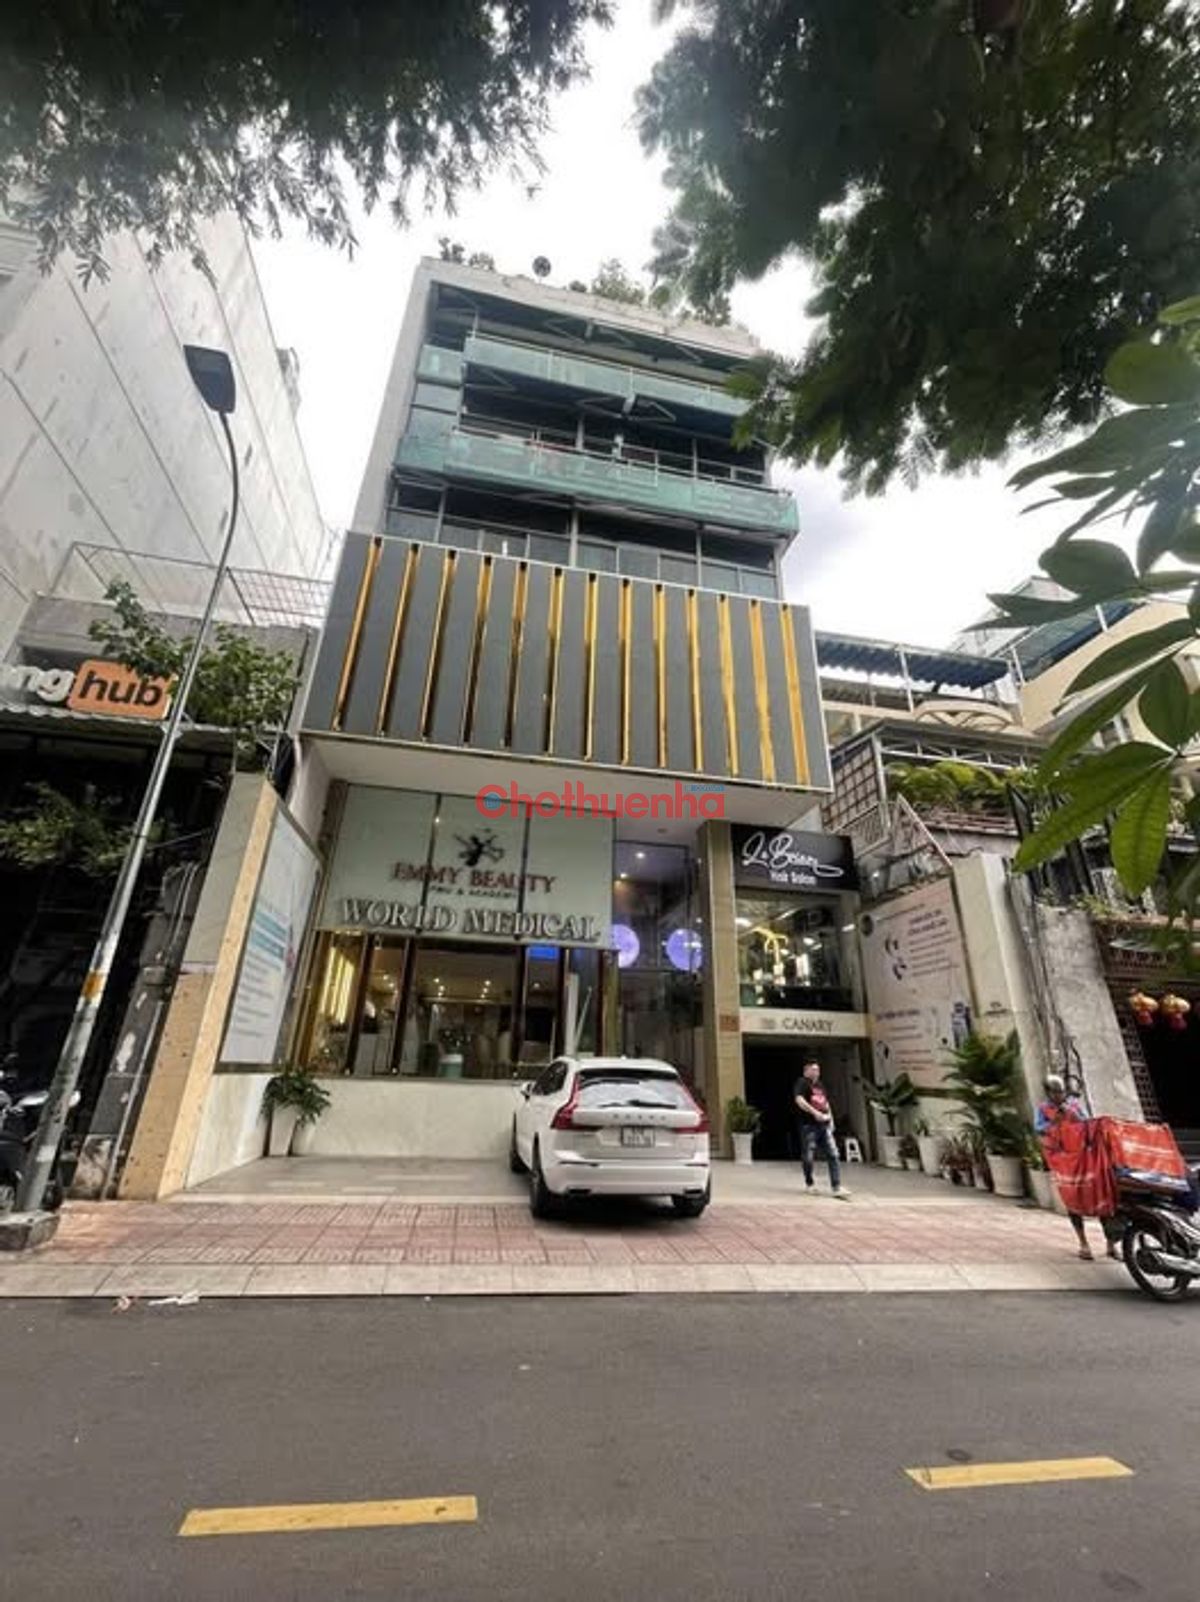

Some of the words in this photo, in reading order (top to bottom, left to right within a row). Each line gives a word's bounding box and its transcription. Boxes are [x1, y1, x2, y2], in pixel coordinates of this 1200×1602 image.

[78, 671, 162, 707] hub
[389, 862, 463, 885] EMMY
[470, 869, 557, 893] BEAUTY
[341, 900, 458, 931] WORLD
[463, 907, 602, 941] MEDICAL
[783, 1017, 834, 1034] CANARY
